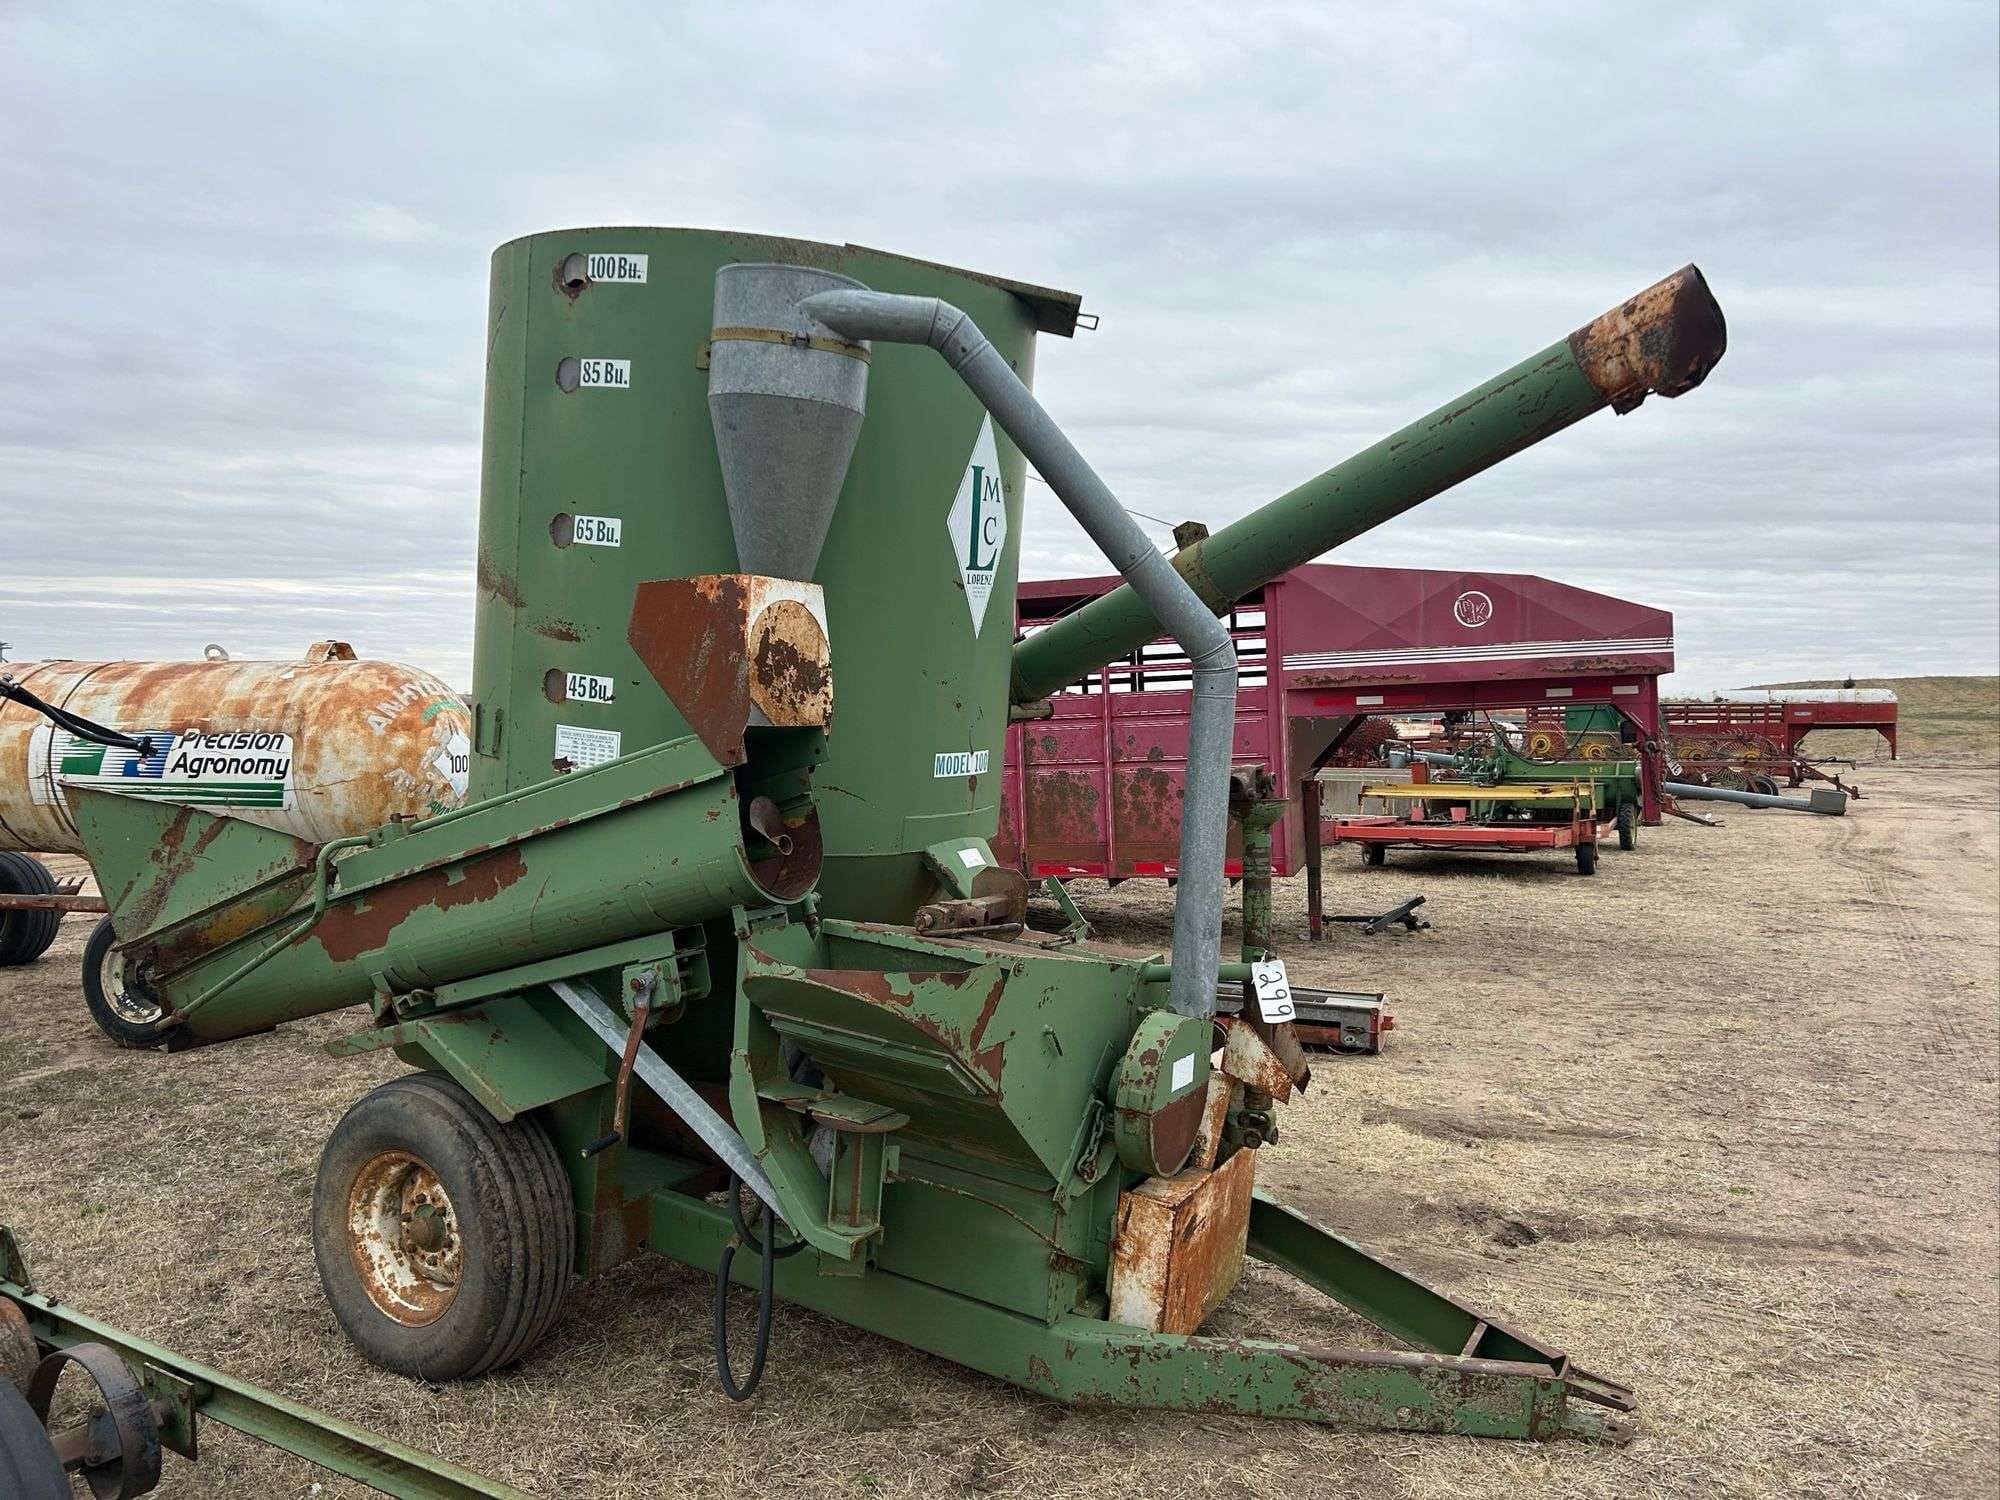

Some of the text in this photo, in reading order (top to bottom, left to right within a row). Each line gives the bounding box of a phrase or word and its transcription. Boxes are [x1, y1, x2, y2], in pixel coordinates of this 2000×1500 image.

[590, 256, 642, 279] 100 Bu.
[582, 361, 628, 385] 85 Bu.
[576, 518, 619, 544] 65 Bu.
[966, 573, 993, 586] LORENZ
[568, 675, 587, 698] 45
[178, 731, 285, 751] Precision
[170, 751, 291, 780] Agronomy
[935, 752, 988, 776] MODEL 100
[1259, 970, 1293, 1017] 299
